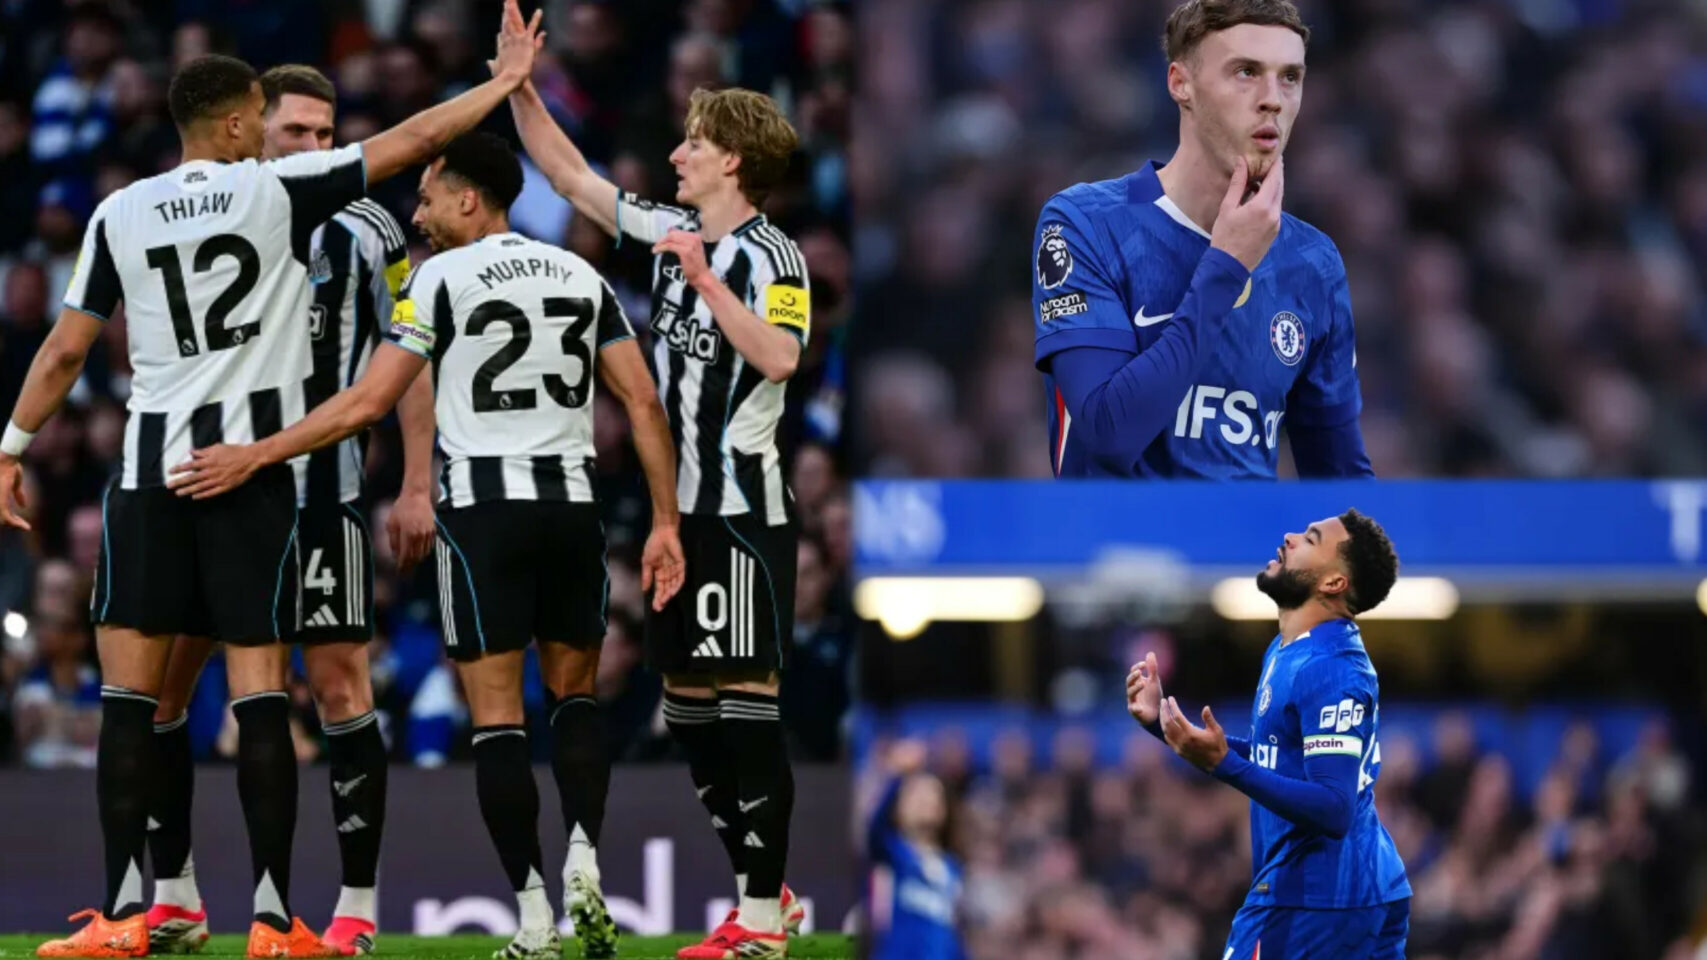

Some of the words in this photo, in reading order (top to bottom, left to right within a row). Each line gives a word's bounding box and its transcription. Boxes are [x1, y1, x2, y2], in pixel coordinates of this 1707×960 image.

[154, 192, 234, 223] THIAW
[476, 258, 573, 290] MURPHY
[145, 233, 261, 358] 12
[768, 307, 806, 324] noon
[1049, 293, 1080, 309] room
[464, 297, 595, 413] 23
[304, 547, 337, 596] 4
[697, 581, 728, 631] 0
